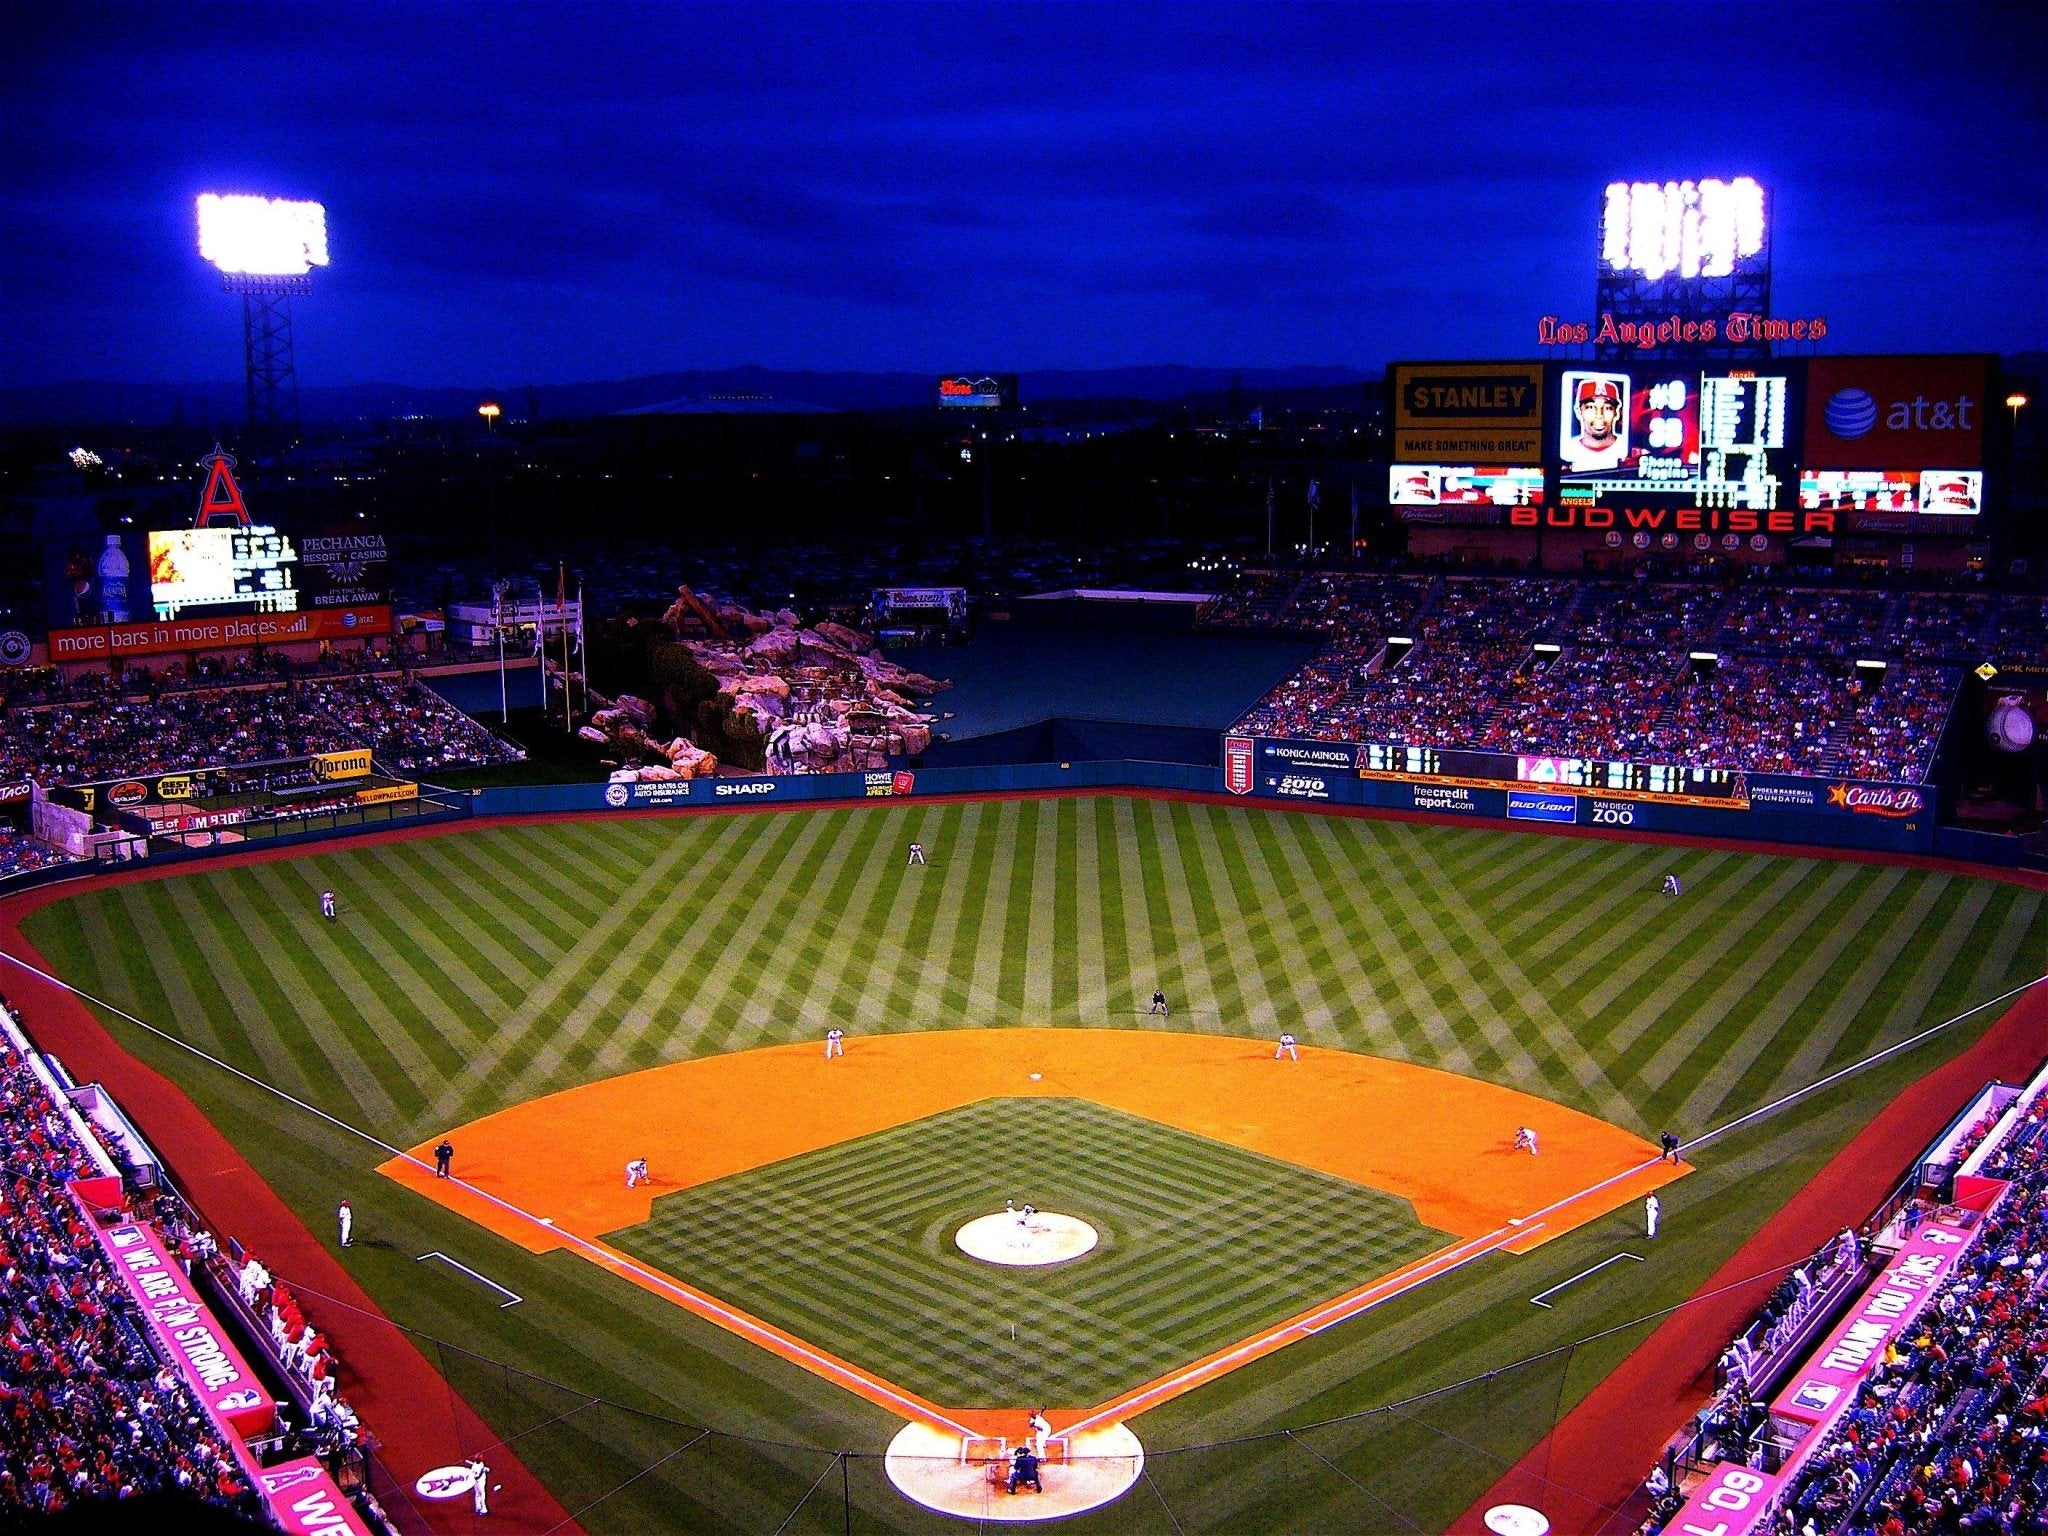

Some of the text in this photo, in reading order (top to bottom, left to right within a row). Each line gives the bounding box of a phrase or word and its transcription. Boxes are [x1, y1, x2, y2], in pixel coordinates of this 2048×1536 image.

[1538, 312, 1827, 349] Los Angeles Times
[1728, 372, 1756, 380] Angels
[1413, 387, 1526, 409] STANLEY
[1886, 394, 1974, 431] at&t
[1404, 440, 1433, 451] MAKE
[1436, 440, 1495, 452] SOMETHING
[1561, 497, 1593, 506] ANGELS
[1510, 507, 1835, 532] BUDWEISER
[302, 535, 386, 550] PECHANGA
[303, 550, 387, 563] RESORT CASINO
[315, 592, 380, 605] BREAK AWAY
[58, 620, 278, 651] more bars in more places
[1277, 748, 1350, 762] KONICA MINOLTA
[311, 756, 367, 780] Corona
[865, 773, 892, 781] HOWIE
[1362, 771, 1394, 779] AutoTrader
[162, 781, 188, 789] BEST
[634, 783, 657, 791] LOWER
[1281, 778, 1325, 791] 2010
[1455, 778, 1489, 787] AutoTrader
[1502, 782, 1537, 791] AutoTrader
[0, 784, 30, 800] TACO
[163, 787, 186, 796] BUY
[653, 788, 690, 796] INSURANCE
[716, 783, 776, 796] SHARP
[1277, 787, 1329, 798] All-Star Game
[1414, 785, 1468, 800] freecredit
[1601, 790, 1638, 799] AutoTrader
[1415, 798, 1475, 811] report.com
[1752, 794, 1813, 804] FOUNDATION
[1847, 787, 1922, 809] Carl's Jr.
[1510, 801, 1574, 813] BUD LIGHT
[1593, 801, 1634, 811] SAN DIEGO
[1593, 809, 1633, 824] ZOO
[122, 1247, 240, 1392] WE ARE FAN STRONG.
[1820, 1254, 1946, 1372] THANK YOU FANS.
[1700, 1470, 1764, 1512] '09
